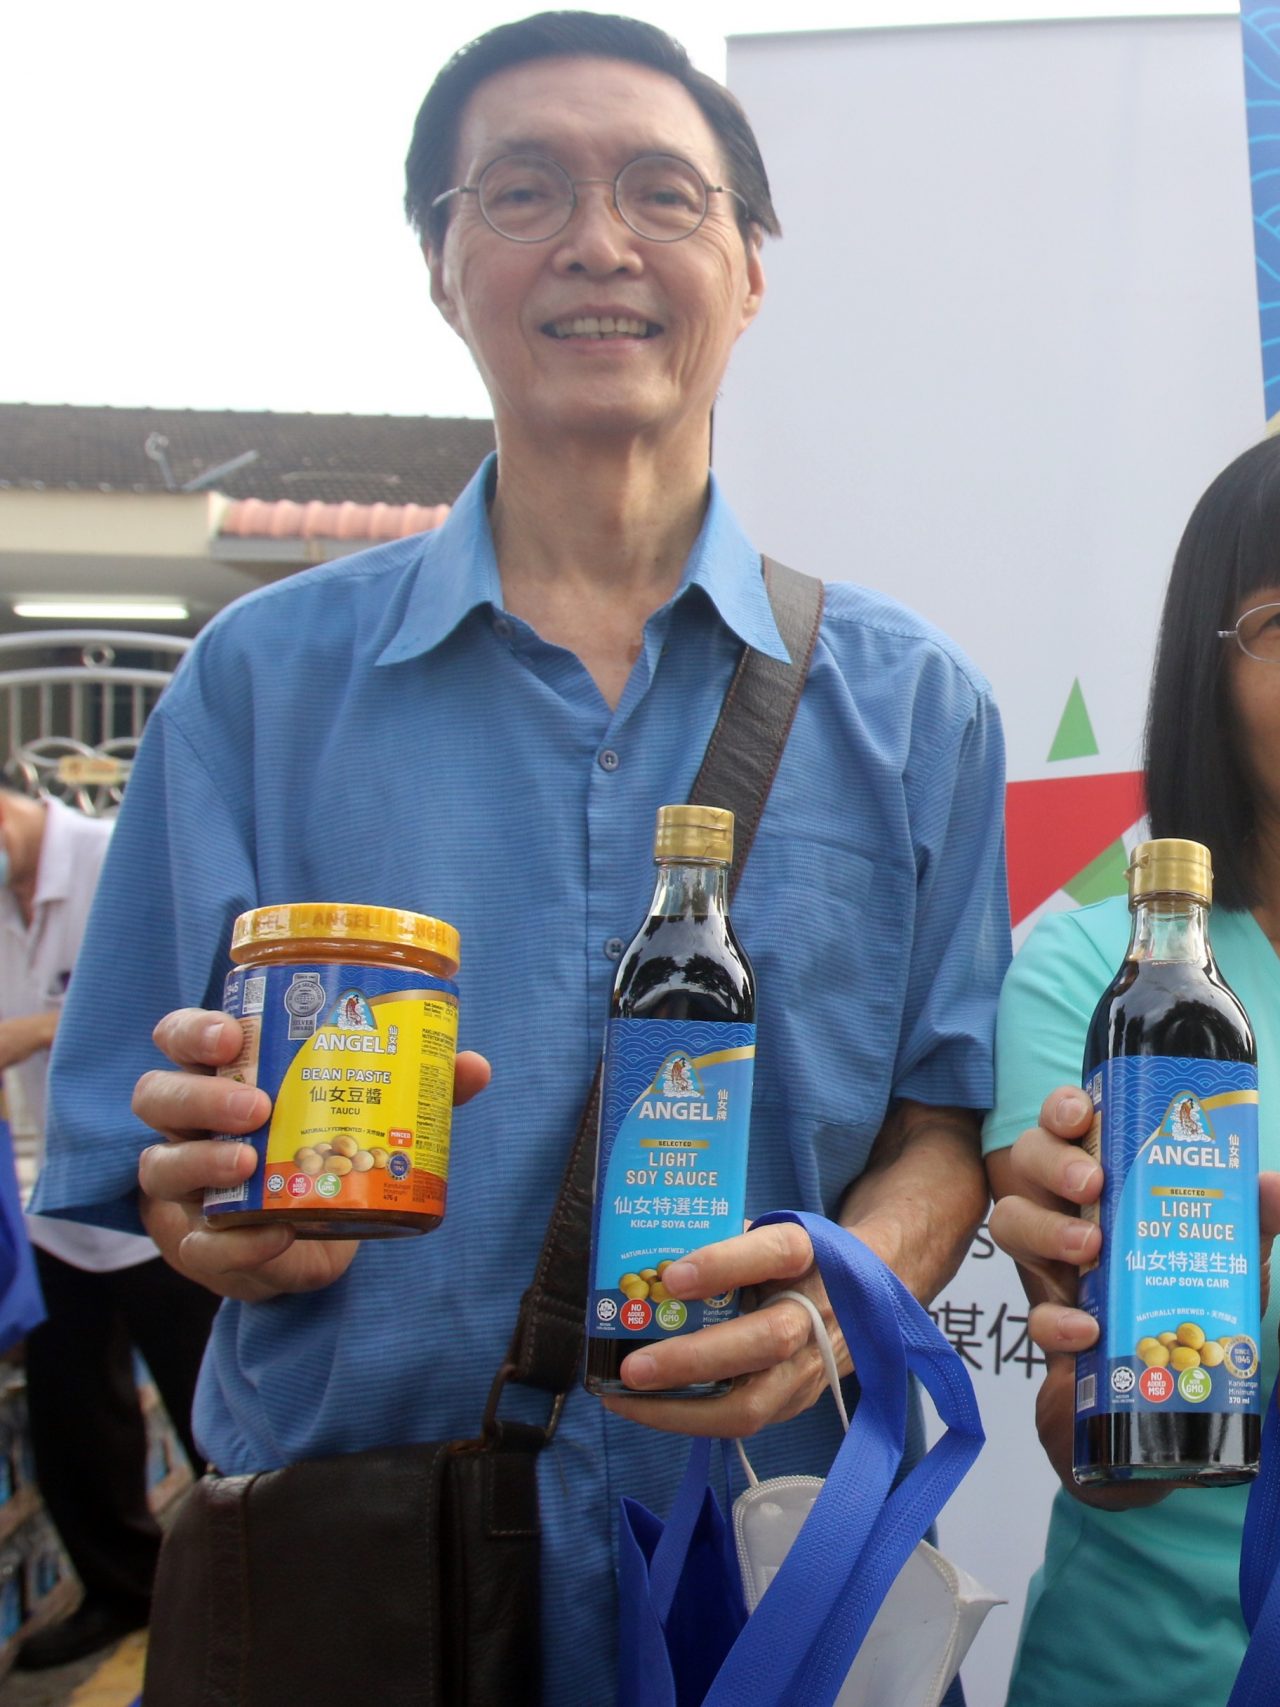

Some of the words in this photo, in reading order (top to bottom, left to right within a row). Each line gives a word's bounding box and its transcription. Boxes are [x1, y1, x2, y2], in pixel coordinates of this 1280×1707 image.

[313, 1033, 385, 1054] ANGEL
[301, 1067, 342, 1082] BEAN
[346, 1068, 392, 1085] PASTE
[331, 1107, 361, 1116] TAUCU
[639, 1101, 714, 1120] ANGEL
[716, 1089, 728, 1121] 仙女牌
[658, 1140, 692, 1148] SELECTED
[1147, 1144, 1226, 1168] ANGEL
[1227, 1133, 1240, 1169] 仙女牌
[649, 1152, 699, 1168] LIGHT
[626, 1170, 658, 1186] SOY
[664, 1171, 719, 1187] SAUCE
[1170, 1188, 1206, 1197] SELECTED
[613, 1195, 729, 1217] 仙女特選生抽
[1161, 1200, 1213, 1219] LIGHT
[630, 1219, 660, 1229] KICAP
[661, 1220, 686, 1229] SOYA
[687, 1220, 710, 1229] CAIR
[1137, 1220, 1172, 1238] SOY
[1178, 1222, 1235, 1241] SAUCE
[620, 1248, 657, 1260] NATURALLY
[1124, 1249, 1248, 1275] 仙女特選生抽
[1145, 1276, 1177, 1286] KICAP
[1178, 1277, 1205, 1287] SOYA
[1206, 1278, 1230, 1289] CAIR
[630, 1303, 642, 1312] NO
[628, 1317, 644, 1325] MSG
[662, 1313, 680, 1323] GMO
[1136, 1309, 1176, 1322] NATURALLY
[1176, 1308, 1205, 1316] BREWED
[1235, 1355, 1251, 1365] 1945
[1150, 1371, 1163, 1381] NO
[1148, 1387, 1165, 1397] MSG
[1186, 1383, 1204, 1394] GMO
[1228, 1396, 1241, 1405] 370
[1241, 1397, 1250, 1405] ml
